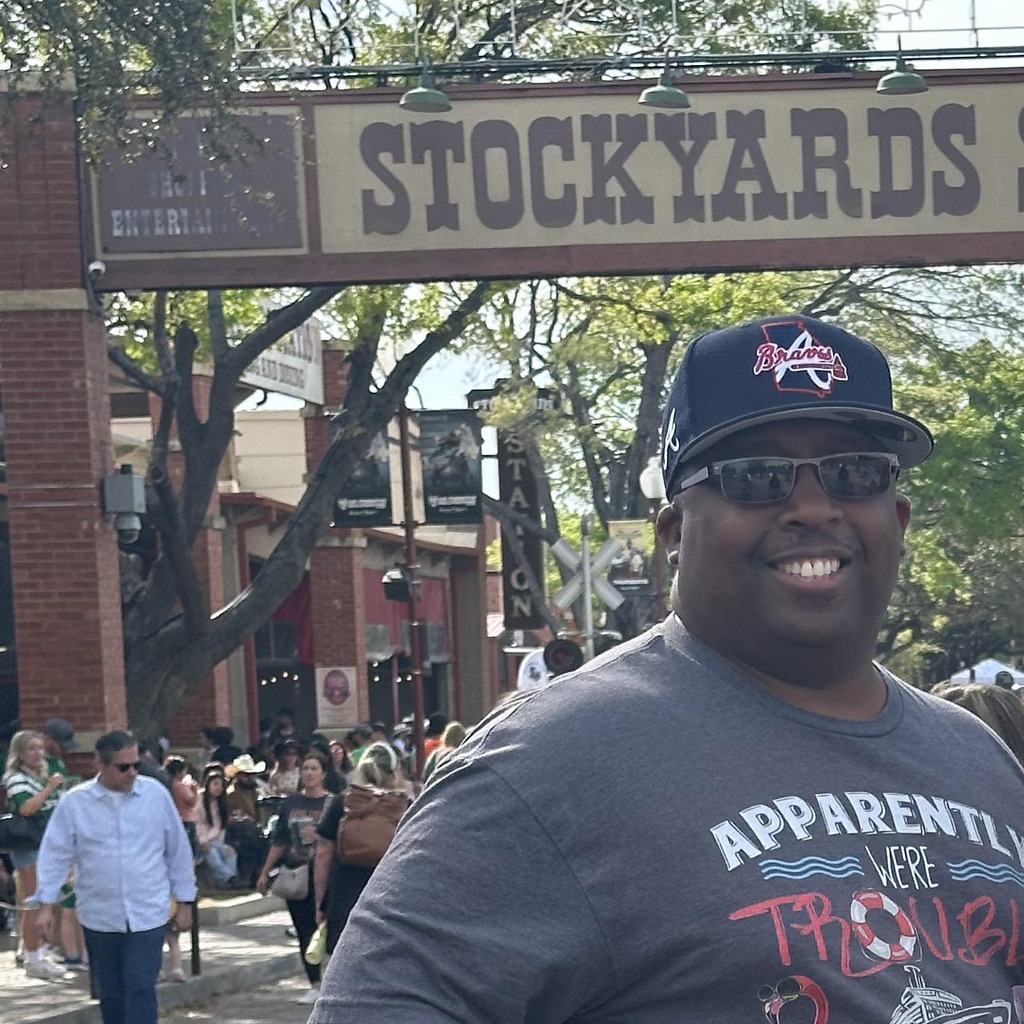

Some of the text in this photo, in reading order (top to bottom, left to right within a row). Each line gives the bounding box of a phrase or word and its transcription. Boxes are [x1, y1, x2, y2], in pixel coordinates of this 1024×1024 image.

[360, 103, 981, 234] STOCKYARDS
[754, 343, 834, 375] Braves
[502, 433, 532, 618] STAON
